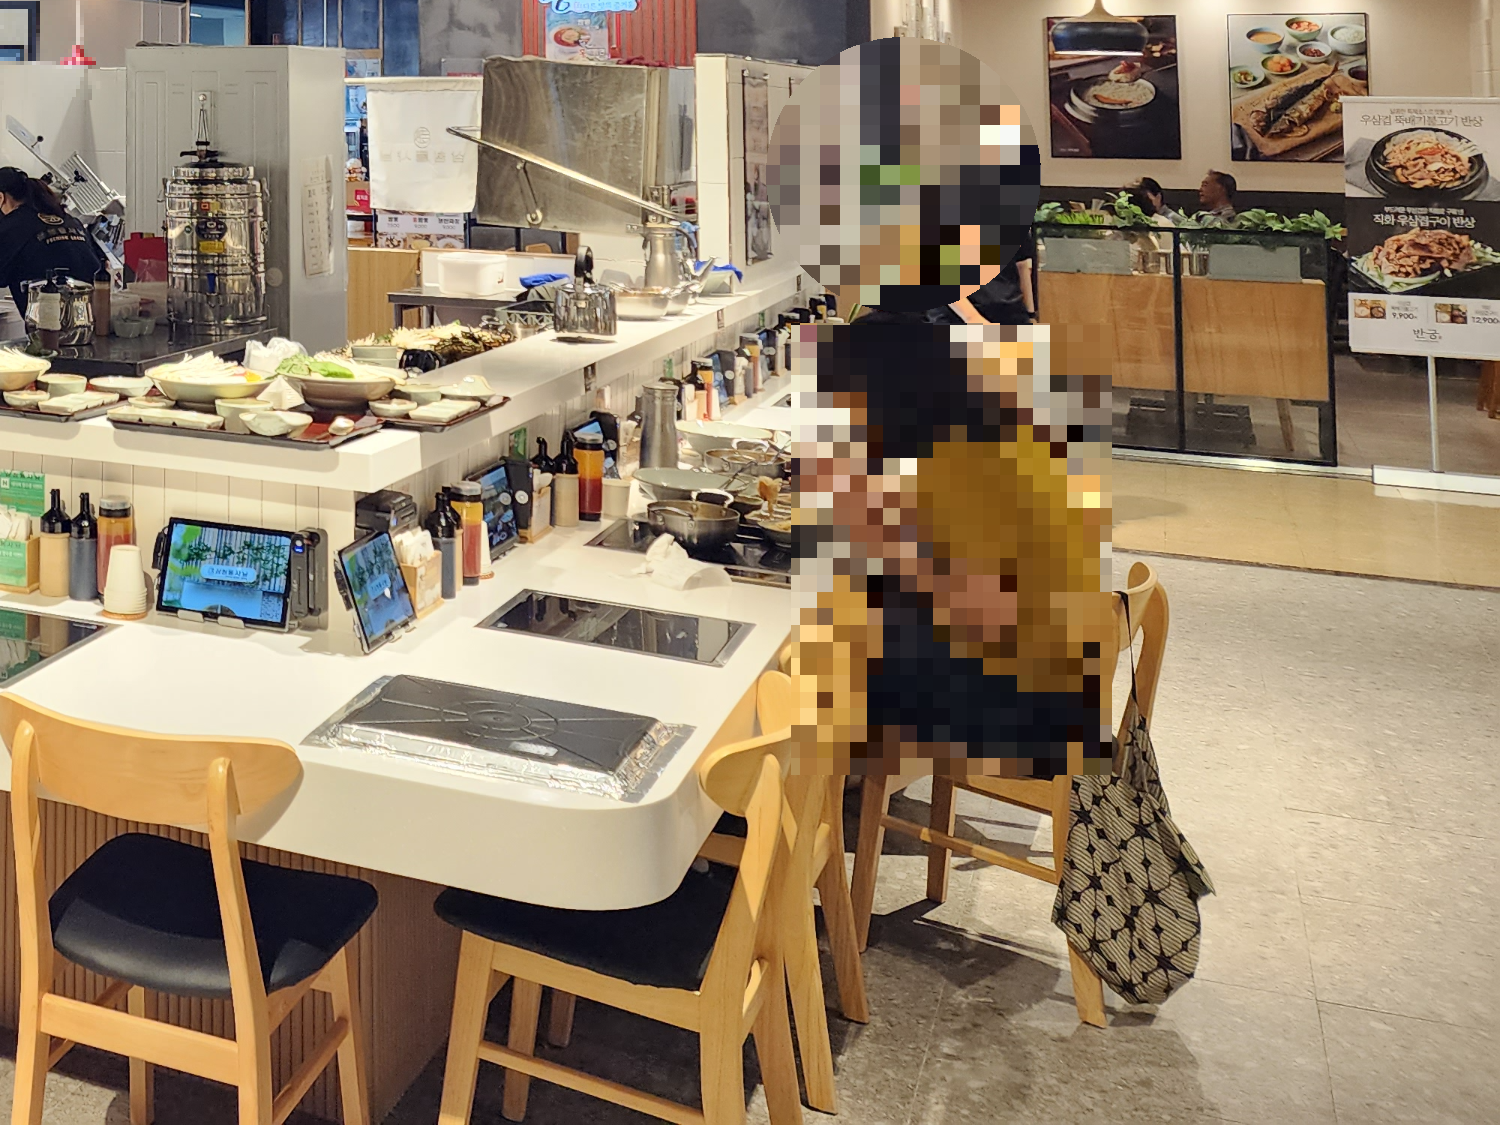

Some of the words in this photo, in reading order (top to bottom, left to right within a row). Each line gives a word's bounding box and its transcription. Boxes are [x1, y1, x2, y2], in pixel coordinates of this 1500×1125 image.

[1360, 115, 1391, 125] 우삼겹
[1461, 116, 1483, 127] 반상
[1373, 214, 1395, 225] 직화
[1398, 215, 1451, 227] 우삼겹구이
[1452, 216, 1476, 228] 반상
